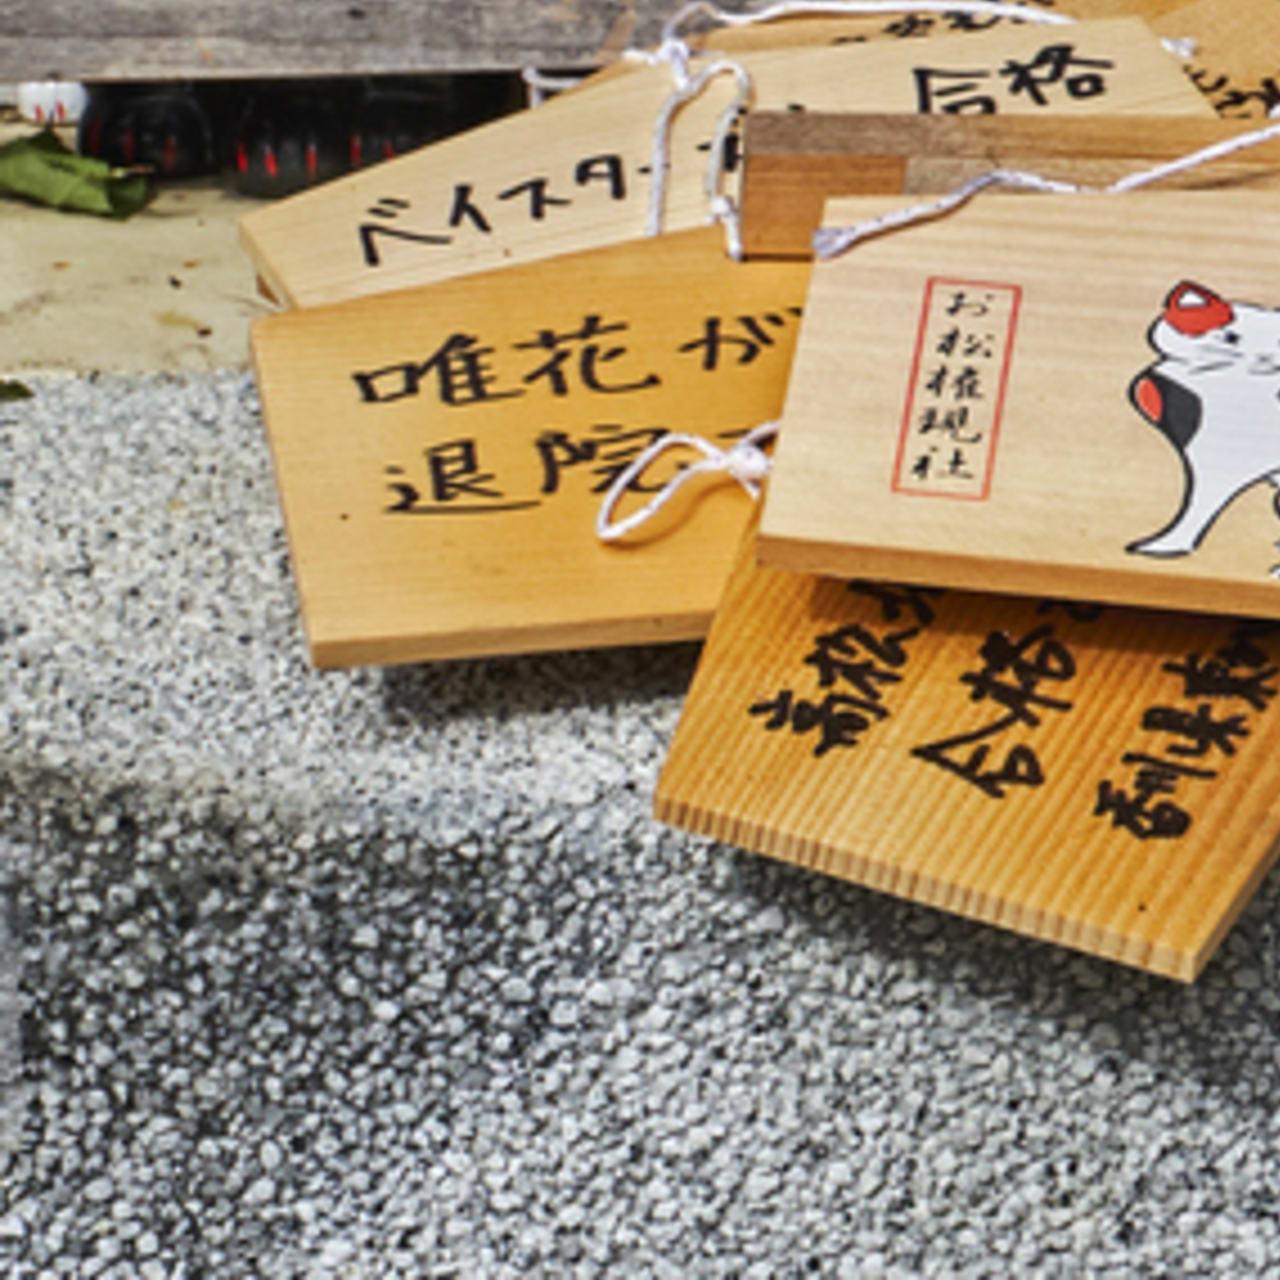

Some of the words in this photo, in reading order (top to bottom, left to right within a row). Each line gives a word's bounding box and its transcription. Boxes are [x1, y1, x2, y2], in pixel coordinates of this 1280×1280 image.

[351, 306, 805, 408] 唯花が
[911, 291, 996, 480] お松権現社
[382, 424, 780, 515] 退院
